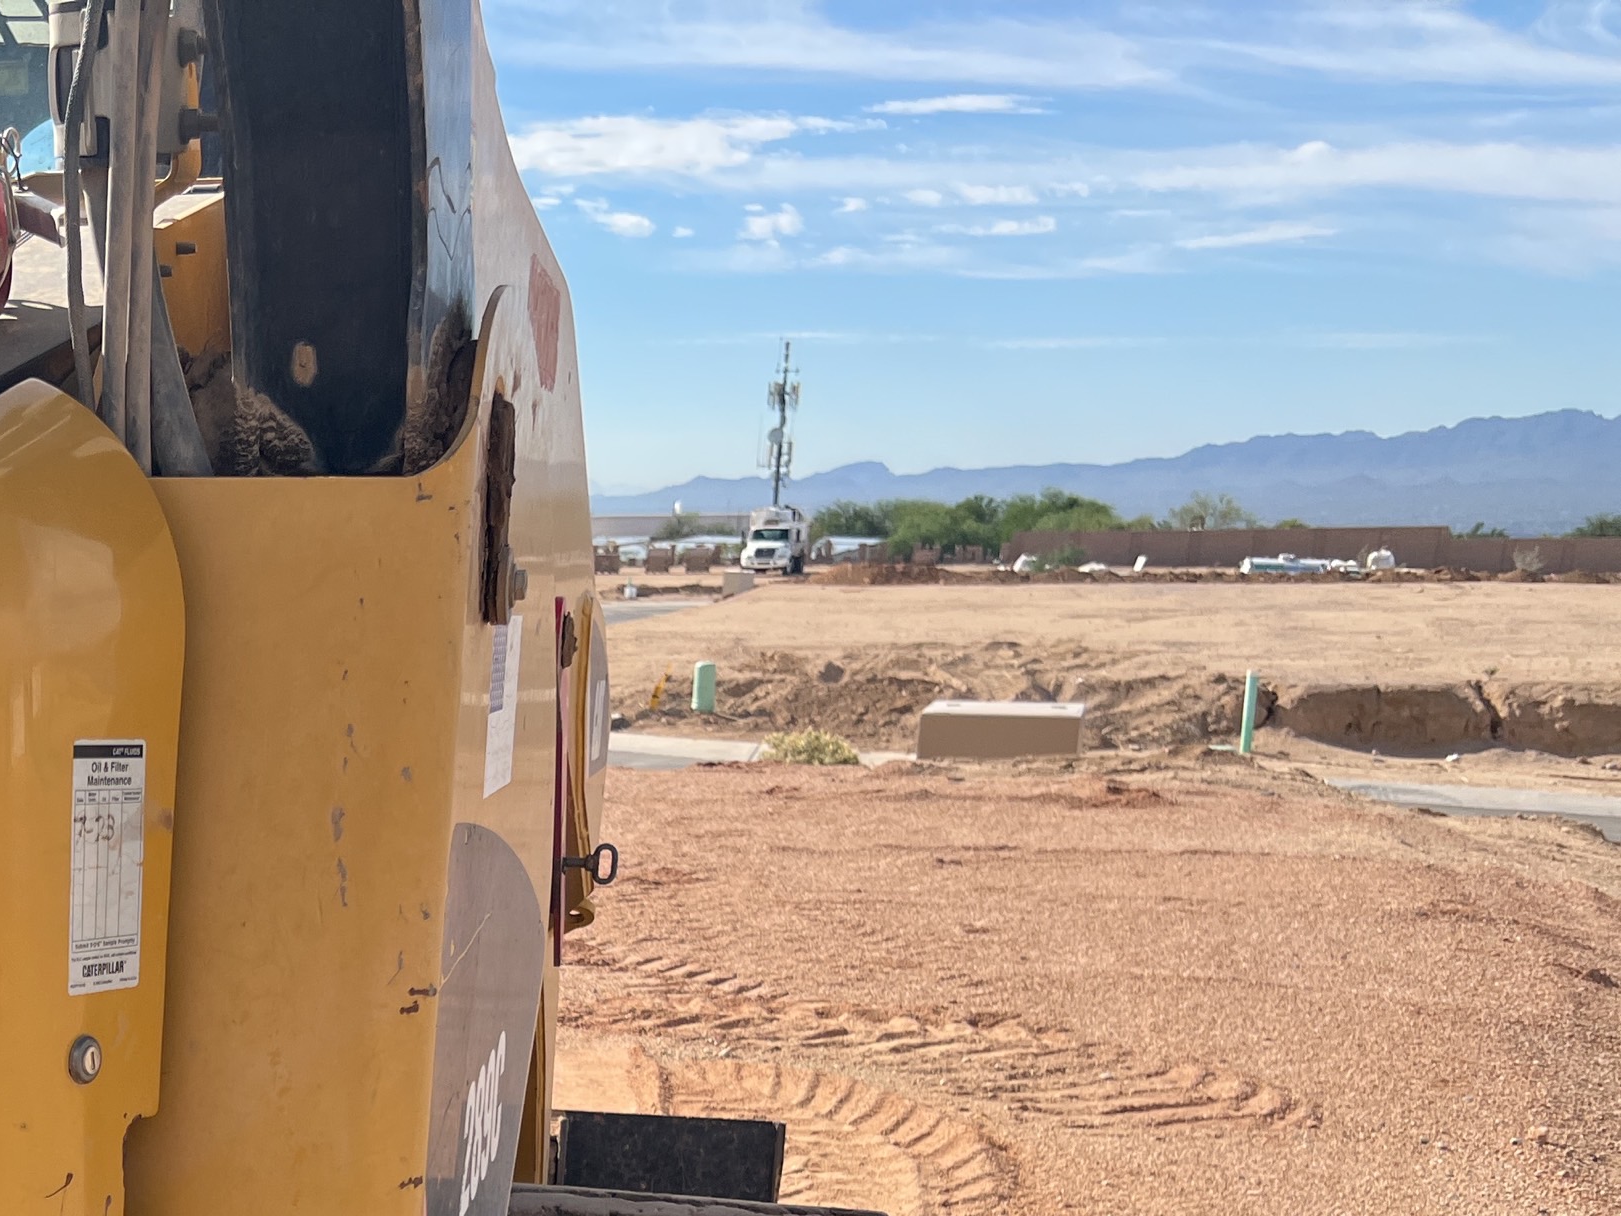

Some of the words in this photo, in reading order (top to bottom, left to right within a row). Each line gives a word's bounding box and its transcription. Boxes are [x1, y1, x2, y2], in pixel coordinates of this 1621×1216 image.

[91, 762, 101, 773] Oil
[103, 762, 109, 773] &
[110, 761, 129, 773] Filter
[87, 775, 132, 787] Maintenance
[82, 961, 124, 978] CATERPILLAR
